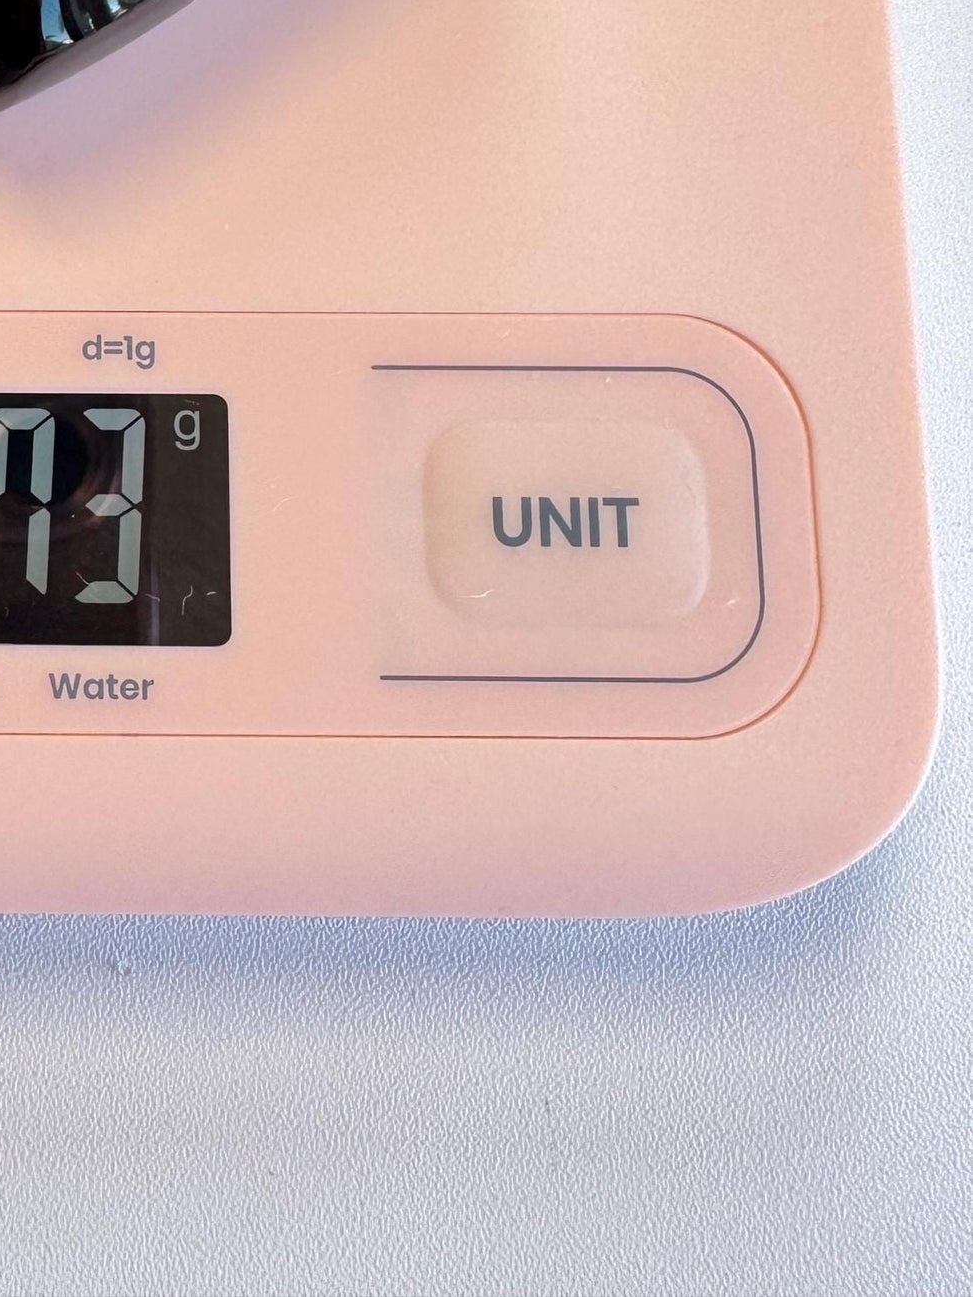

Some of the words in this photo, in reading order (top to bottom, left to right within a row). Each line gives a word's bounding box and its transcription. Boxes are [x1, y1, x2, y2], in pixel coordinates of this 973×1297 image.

[81, 335, 157, 370] d=1g
[173, 408, 202, 451] g
[492, 496, 640, 548] UNIT
[49, 672, 155, 702] Water
